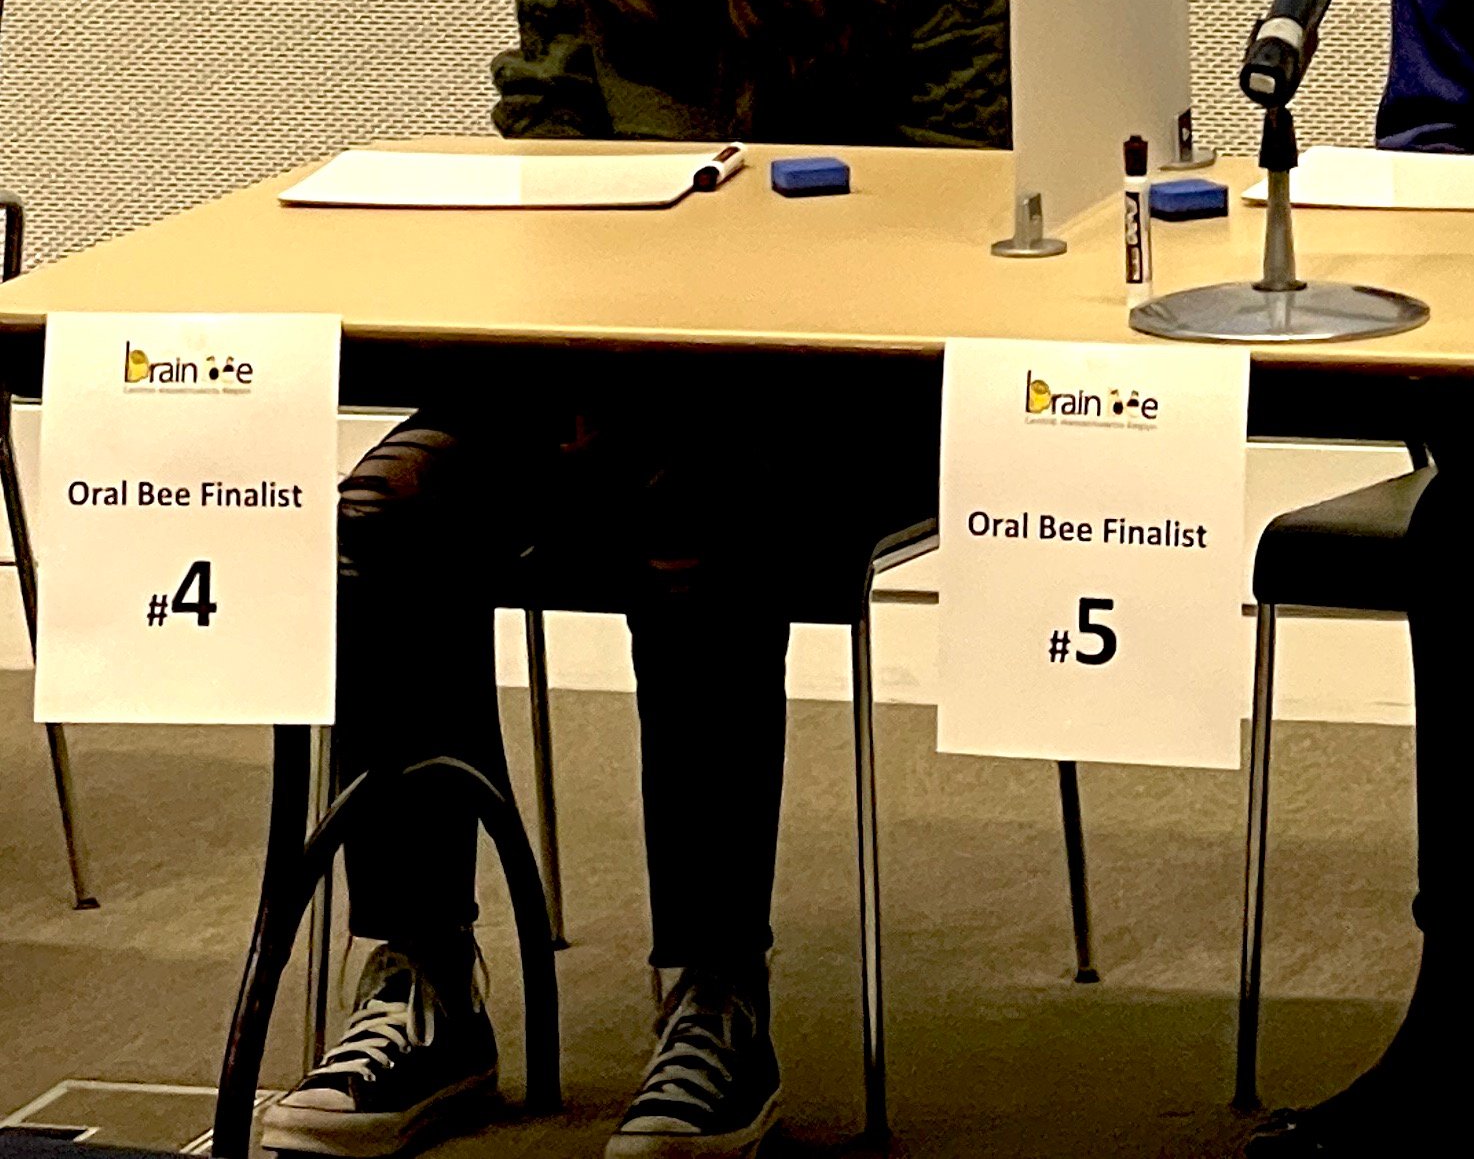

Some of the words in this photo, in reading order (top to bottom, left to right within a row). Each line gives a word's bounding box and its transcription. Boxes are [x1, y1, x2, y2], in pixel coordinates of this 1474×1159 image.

[68, 479, 127, 507] Oral
[138, 481, 191, 508] Bee
[201, 480, 303, 509] Finalist
[968, 511, 1028, 539] Oral
[1039, 514, 1093, 543] Bee
[1103, 517, 1208, 549] Finalist
[146, 560, 218, 628] #4
[1048, 597, 1118, 666] #5
